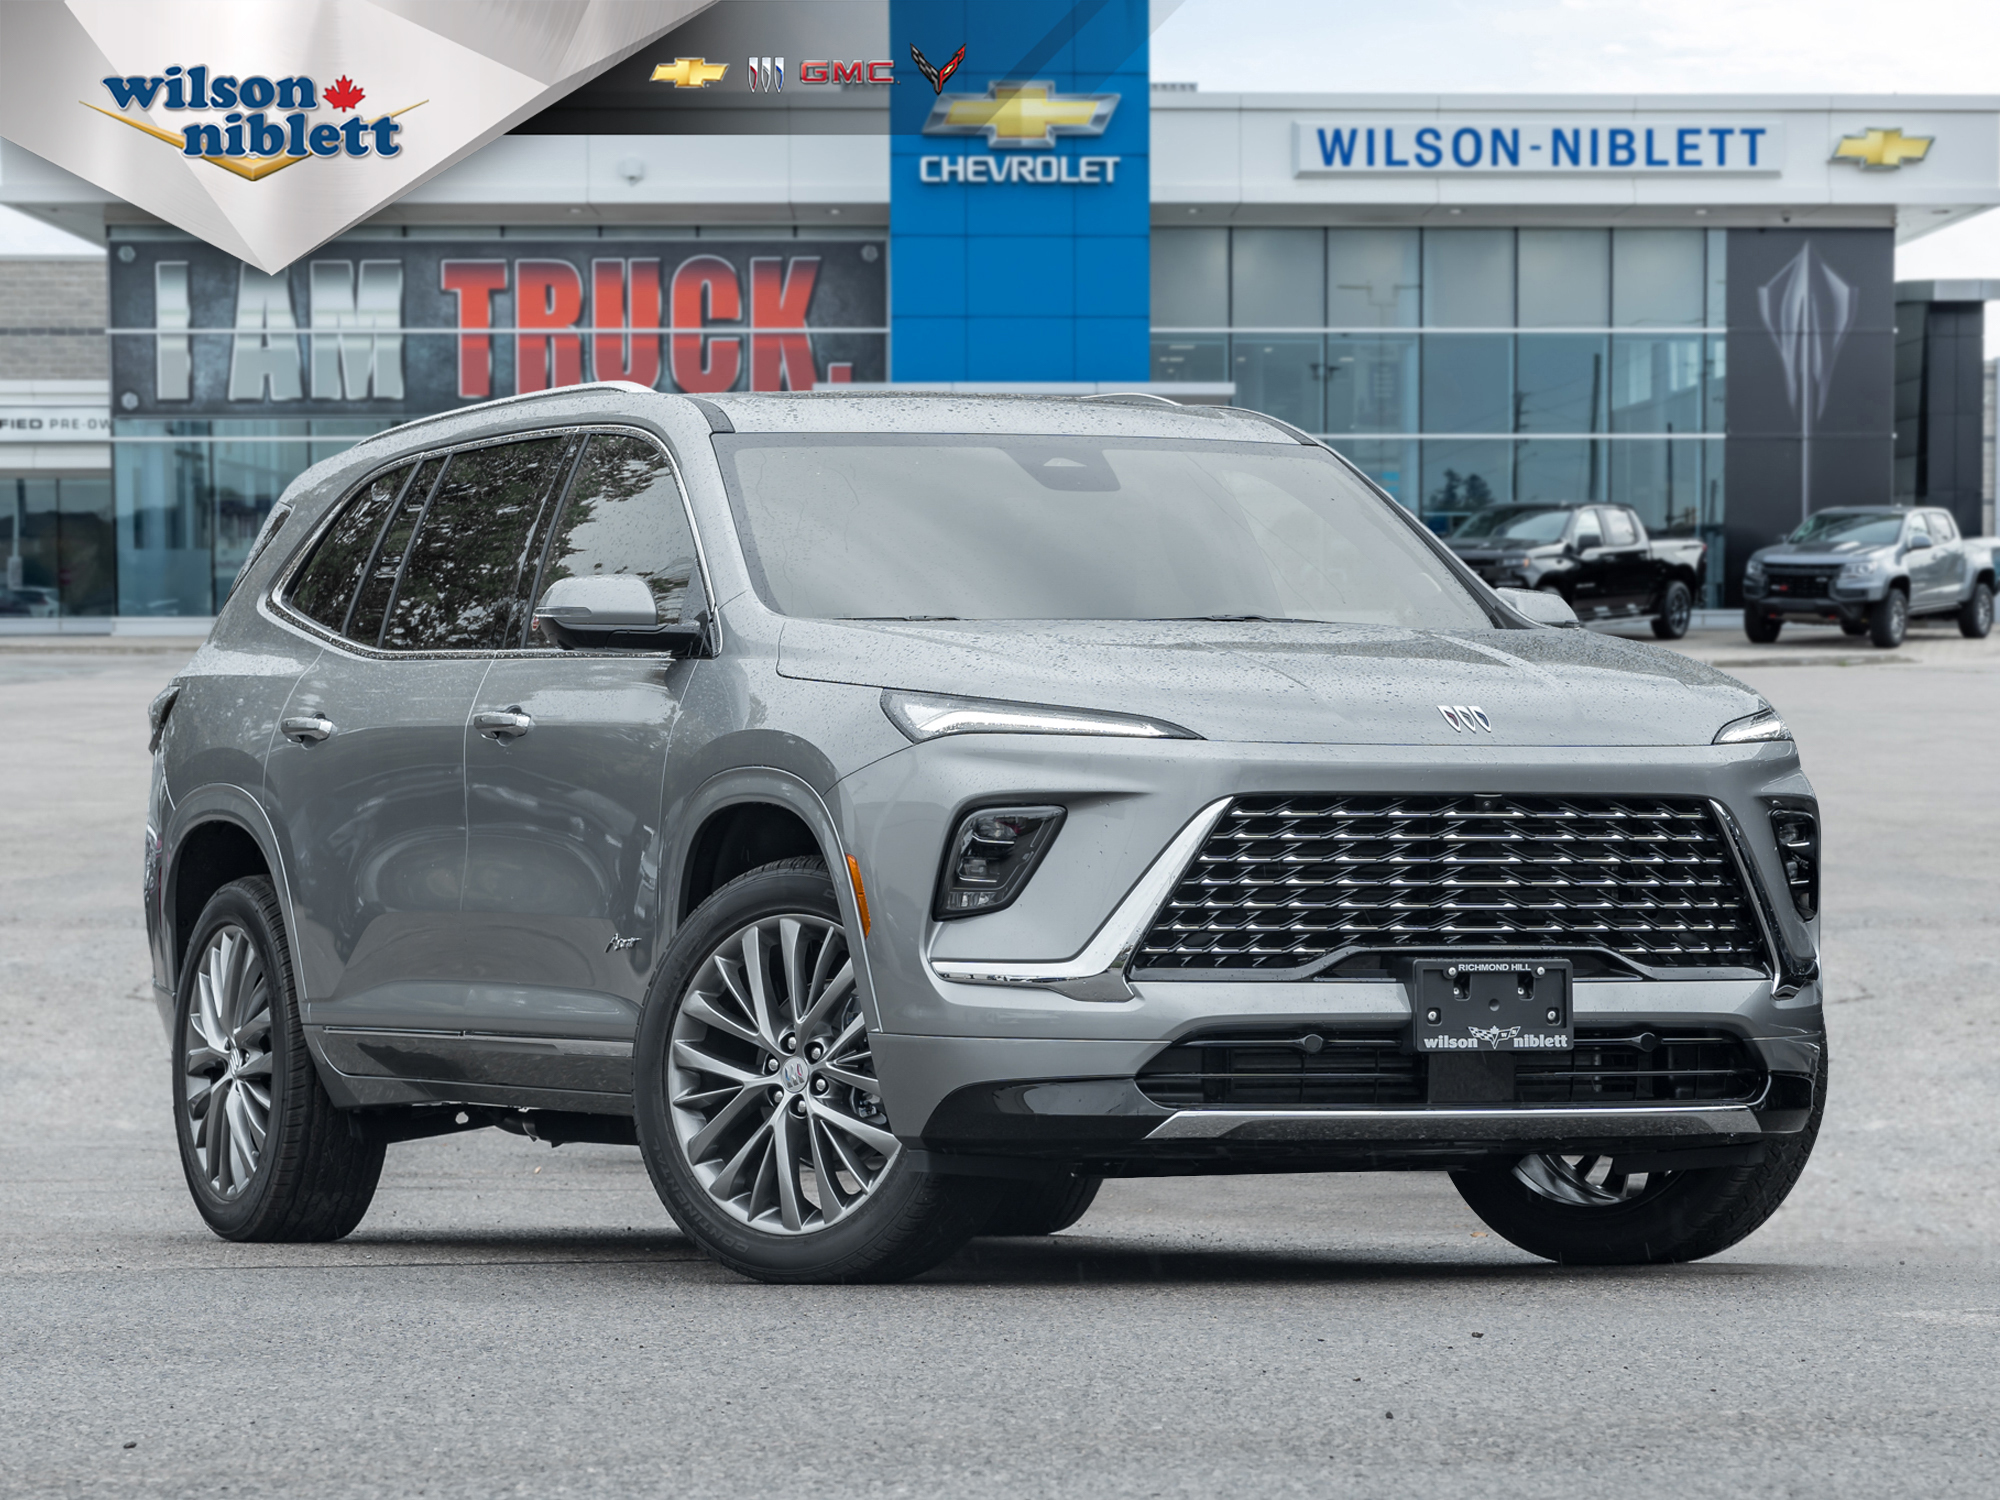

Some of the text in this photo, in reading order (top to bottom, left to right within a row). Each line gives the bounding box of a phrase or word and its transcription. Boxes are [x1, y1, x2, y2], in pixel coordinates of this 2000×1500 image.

[1316, 127, 1767, 167] WILSON-NIBLETT
[919, 155, 1121, 183] CHEVROLET
[156, 254, 853, 401] I AM TRUCK.
[1458, 964, 1531, 972] RICHMOND HILL
[1424, 1034, 1568, 1048] wilson niblett
